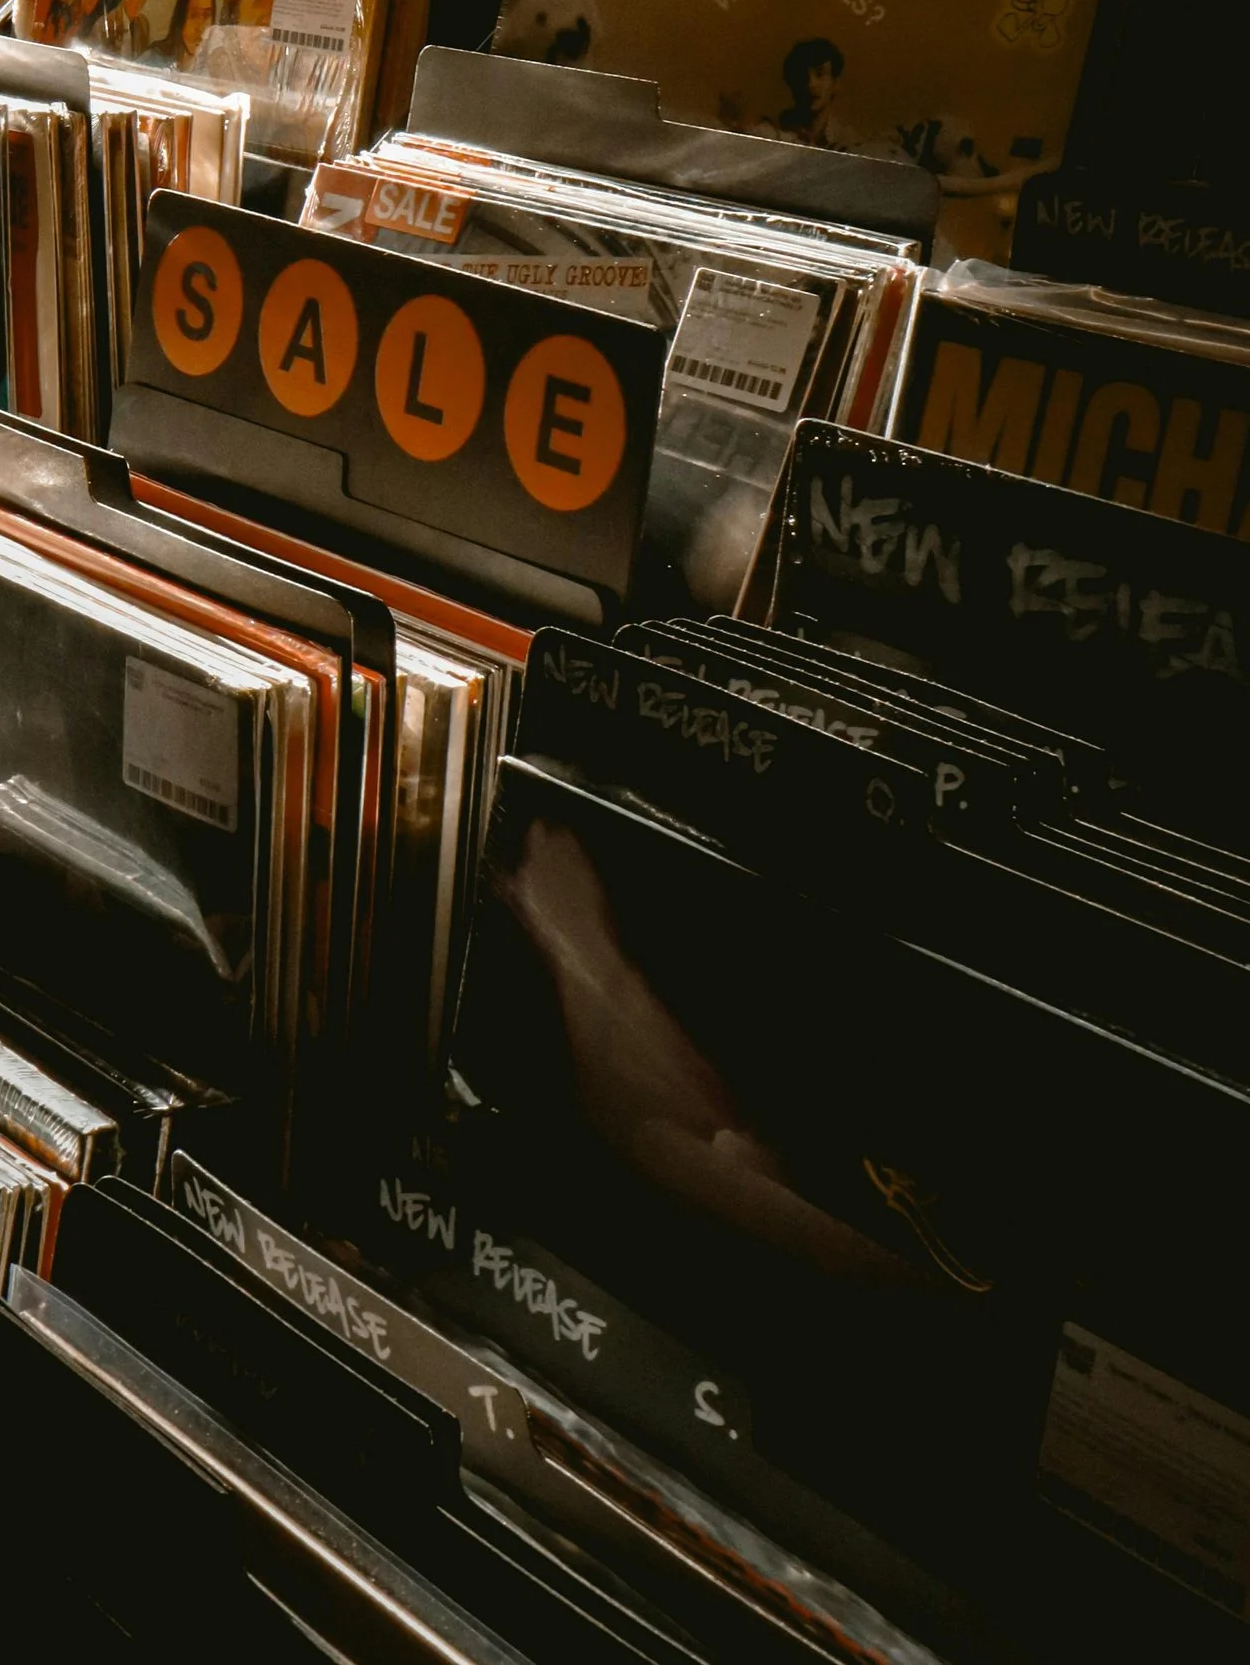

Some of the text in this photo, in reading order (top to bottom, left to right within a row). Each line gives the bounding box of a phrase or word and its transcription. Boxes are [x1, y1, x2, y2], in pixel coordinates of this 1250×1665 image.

[373, 181, 458, 236] SALE
[507, 264, 557, 287] UGLY
[565, 264, 649, 289] GROOVE!
[1036, 194, 1116, 241] NEW
[173, 260, 593, 477] SALE
[918, 340, 1250, 547] MICH
[809, 473, 1250, 687] NEW RELEA
[544, 644, 621, 711] NEW
[636, 681, 778, 776] RELEASE
[933, 760, 969, 811] P.
[184, 1176, 247, 1255] NEW
[258, 1228, 393, 1362] RELEASE
[468, 1383, 516, 1440] T.
[378, 1176, 457, 1251] NEW
[473, 1229, 607, 1362] RELEASE
